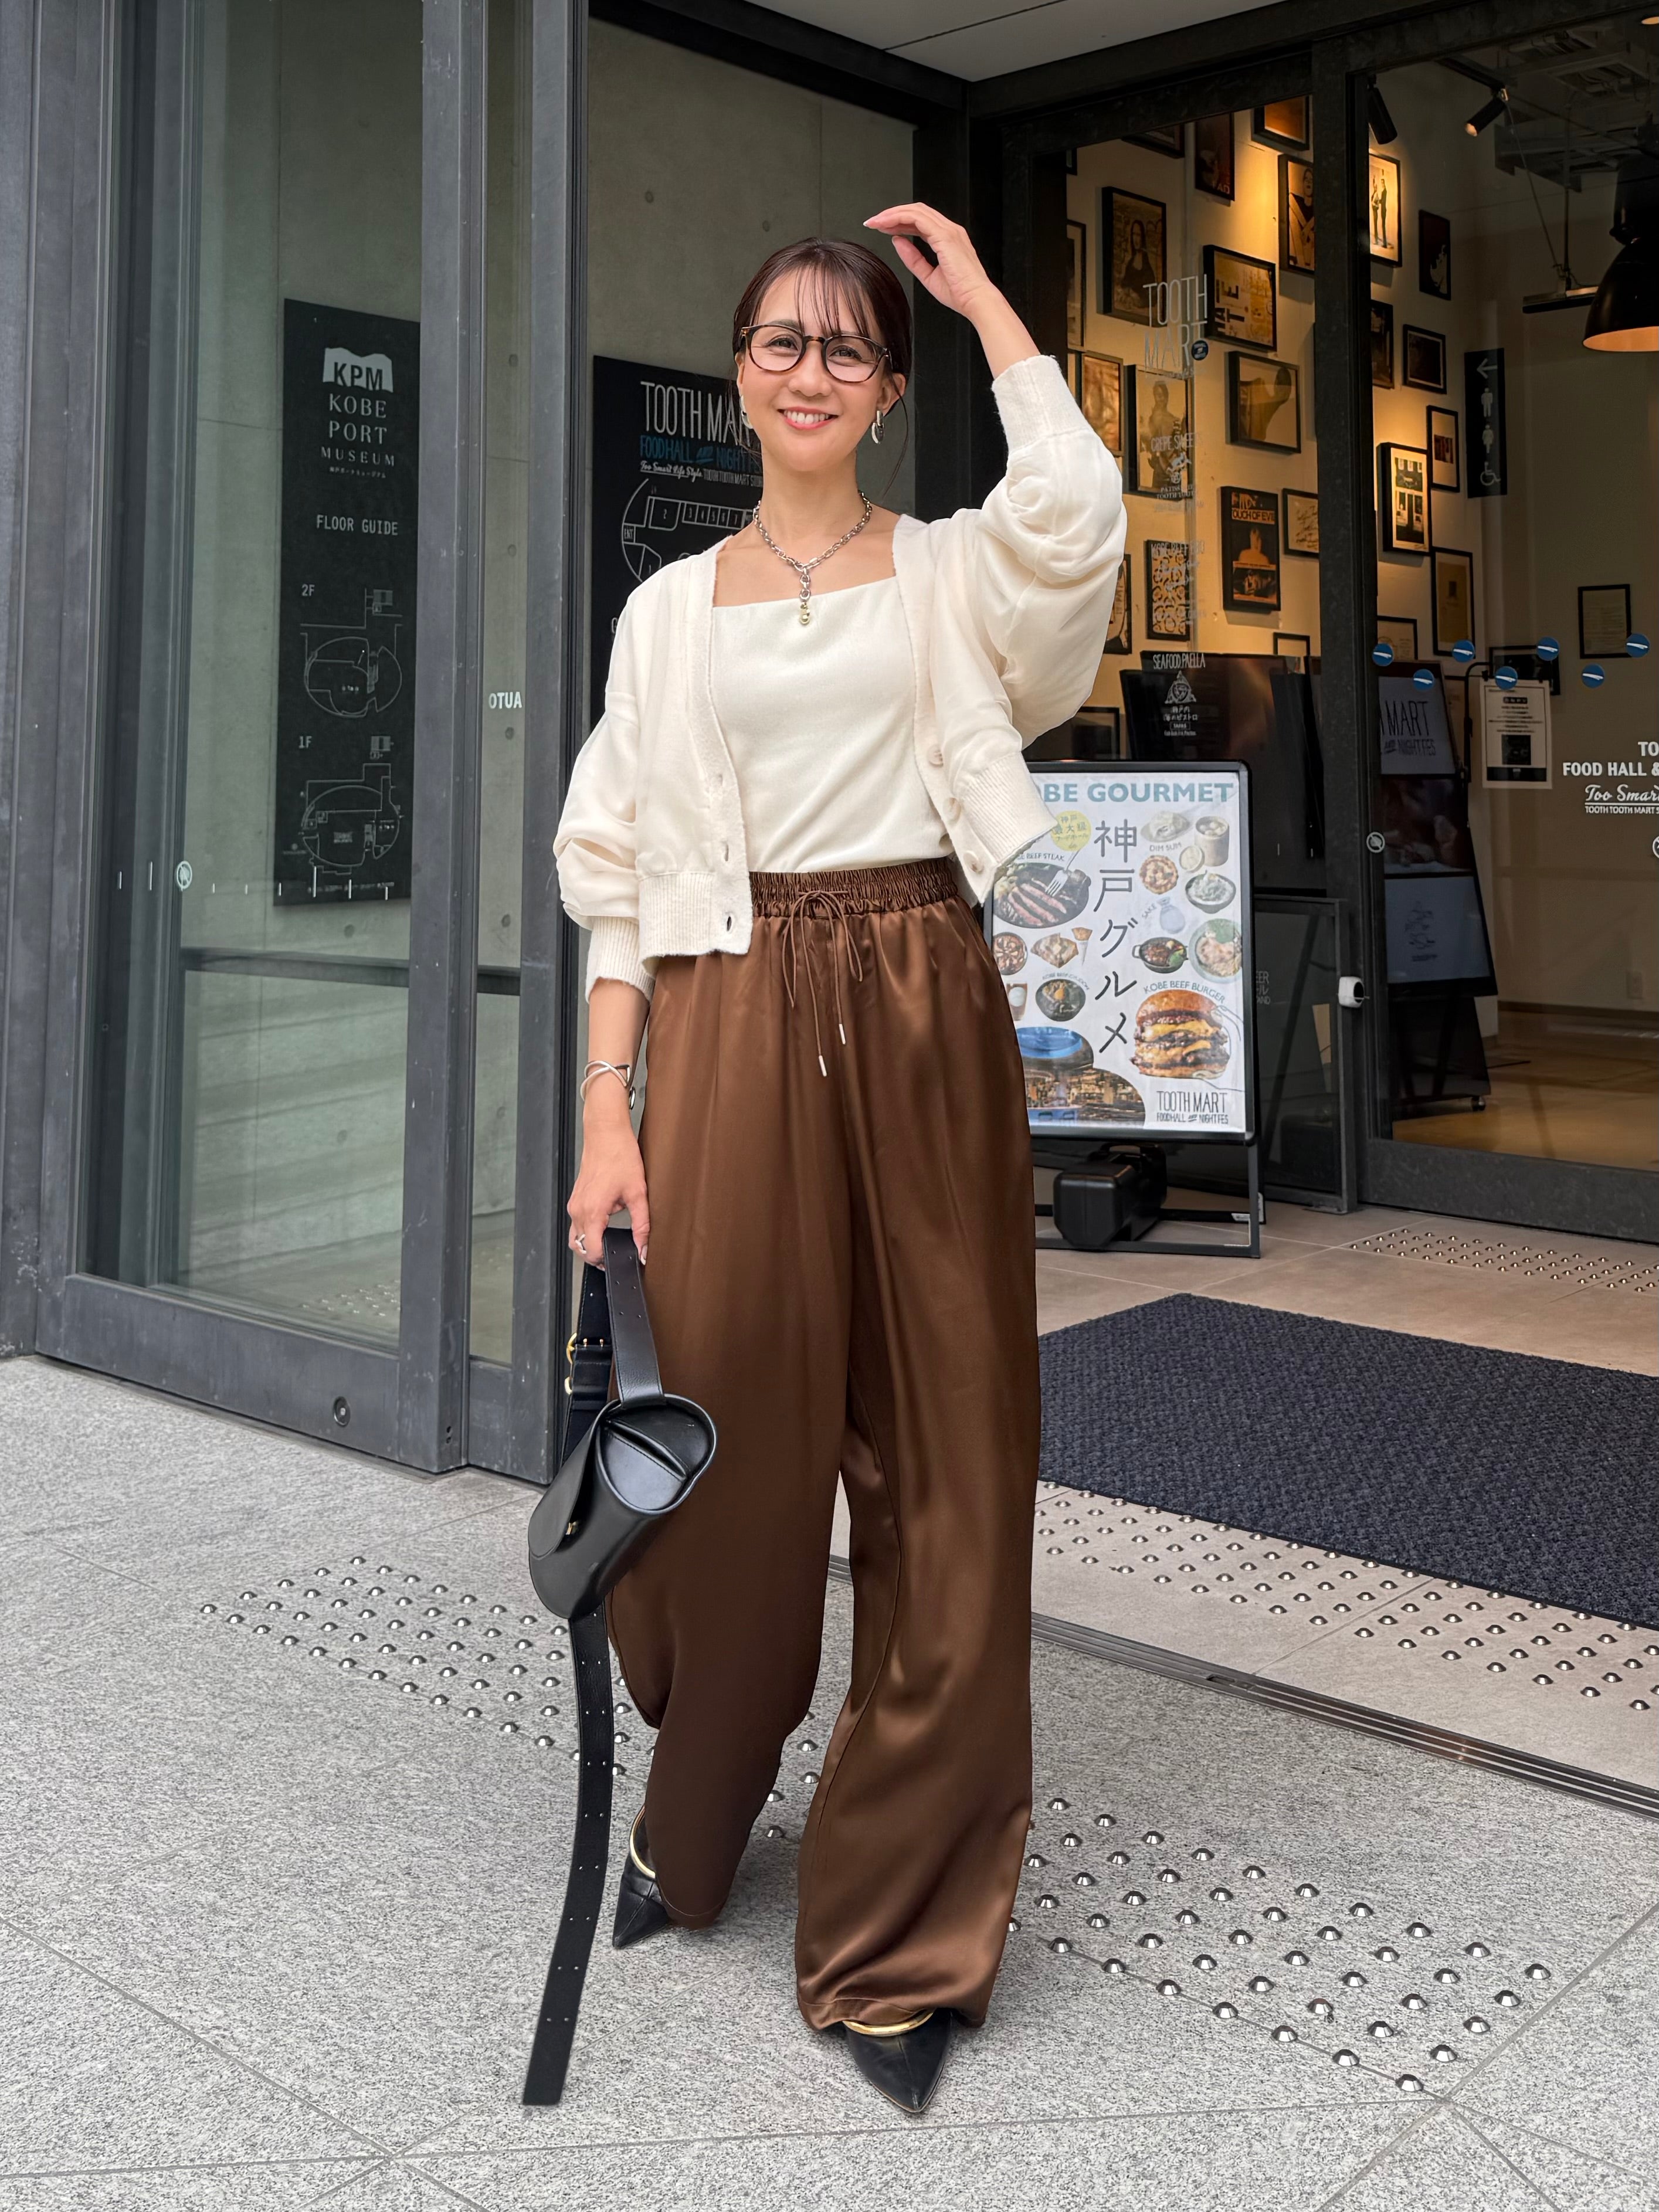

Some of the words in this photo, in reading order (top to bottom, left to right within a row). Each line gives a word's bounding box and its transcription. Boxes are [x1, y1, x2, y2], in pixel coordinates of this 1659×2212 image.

[1142, 274, 1208, 328] TOOTH
[334, 361, 383, 391] KPM
[329, 393, 387, 418] KOBE
[640, 381, 701, 439] TOOTH
[328, 420, 388, 445] PORT
[321, 446, 395, 467] MUSEUM
[316, 514, 354, 531] FLOOR
[362, 518, 399, 535] GUIDE
[662, 508, 667, 520] 2
[301, 584, 315, 597] 2F
[1385, 701, 1430, 737] MART
[298, 735, 312, 749] 1F
[1638, 741, 1659, 756] TO
[1563, 762, 1603, 776] FOOD
[1607, 762, 1647, 776] HALL
[1087, 783, 1234, 803] GOURMET
[1585, 783, 1613, 802] Too
[1617, 783, 1659, 802] Smar
[1585, 806, 1608, 815] TOOTH
[1610, 806, 1633, 815] TOOTH
[1634, 806, 1655, 815] MART
[1166, 842, 1182, 851] SUM
[1093, 819, 1138, 1053] 神戸グルメ
[1144, 981, 1168, 994] KOBE
[1170, 980, 1190, 989] BEEF
[1191, 982, 1226, 1004] BURGER
[1156, 1090, 1190, 1112] TOOTH
[1193, 1091, 1228, 1113] MART
